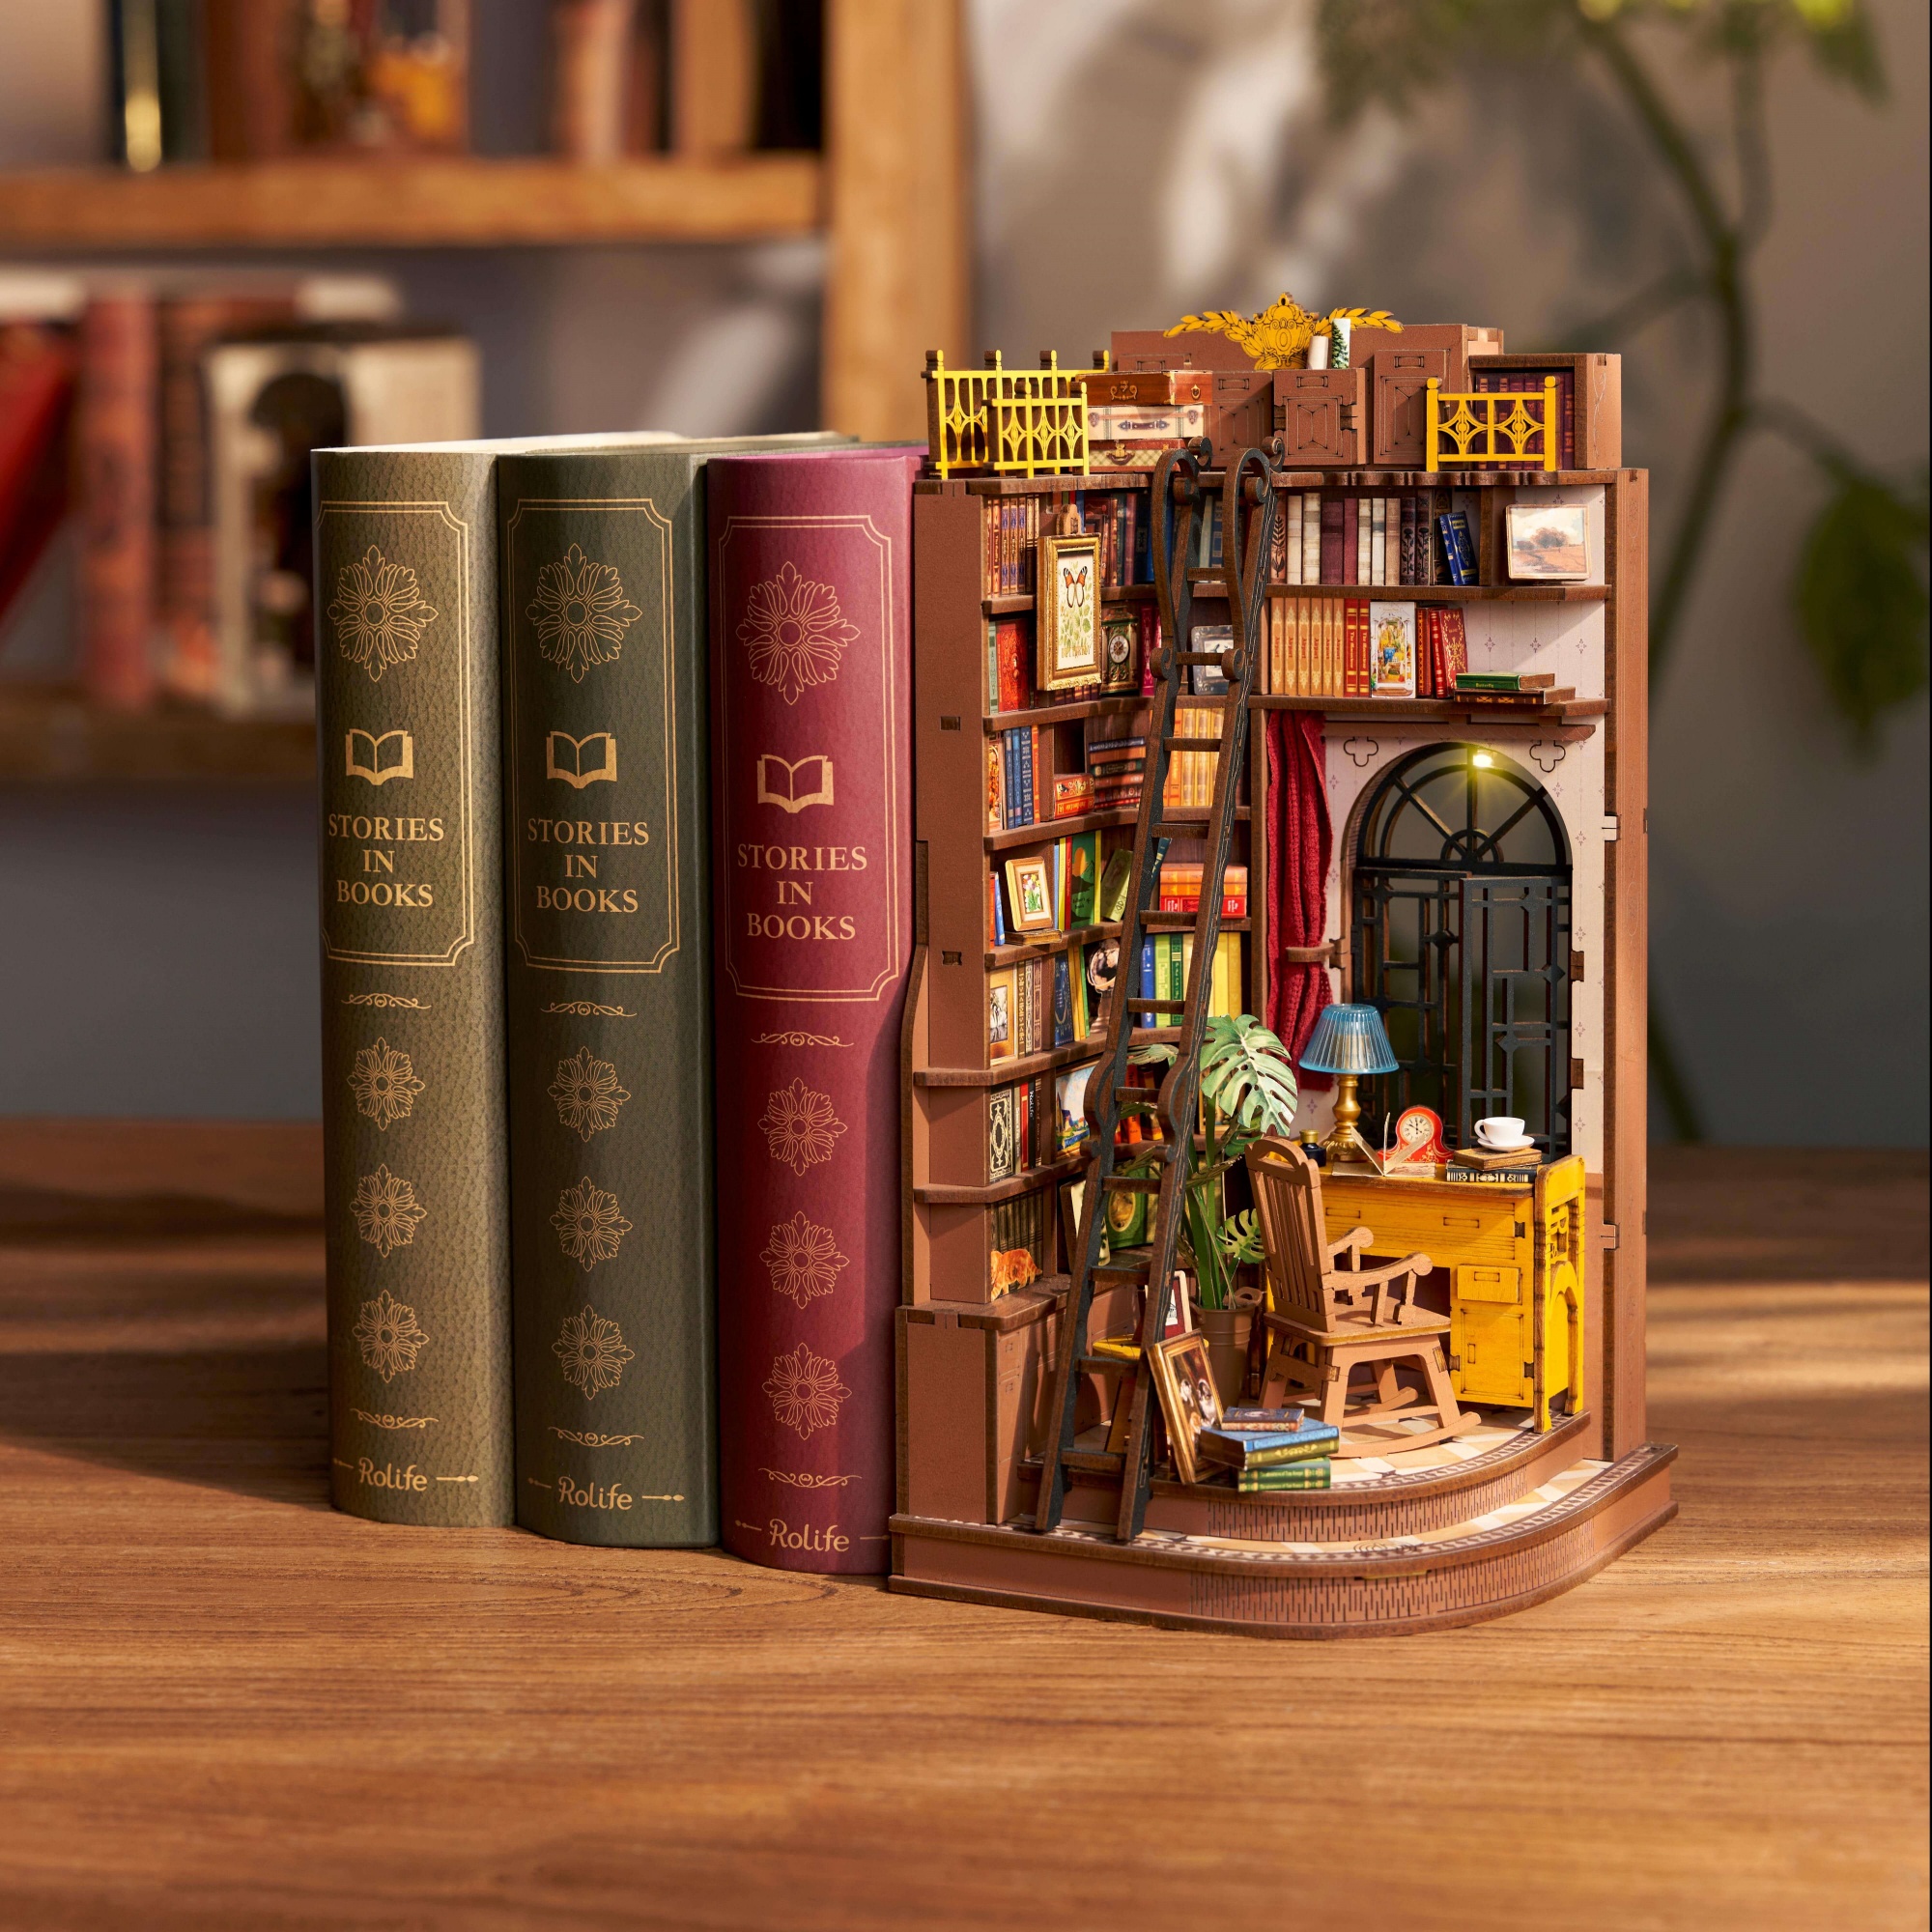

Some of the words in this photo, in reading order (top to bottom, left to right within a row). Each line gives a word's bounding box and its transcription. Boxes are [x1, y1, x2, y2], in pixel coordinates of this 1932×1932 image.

[328, 813, 444, 842] STORIES
[527, 818, 650, 846] STORIES
[362, 849, 394, 873] IN
[564, 854, 599, 879] IN
[737, 842, 868, 871] STORIES
[337, 883, 434, 908] BOOKS
[536, 886, 639, 914] BOOKS
[777, 880, 813, 905] IN
[747, 912, 856, 941] BOOKS
[357, 1457, 429, 1492] Rolife
[558, 1475, 633, 1511] Rolife
[769, 1518, 850, 1553] Rolife
